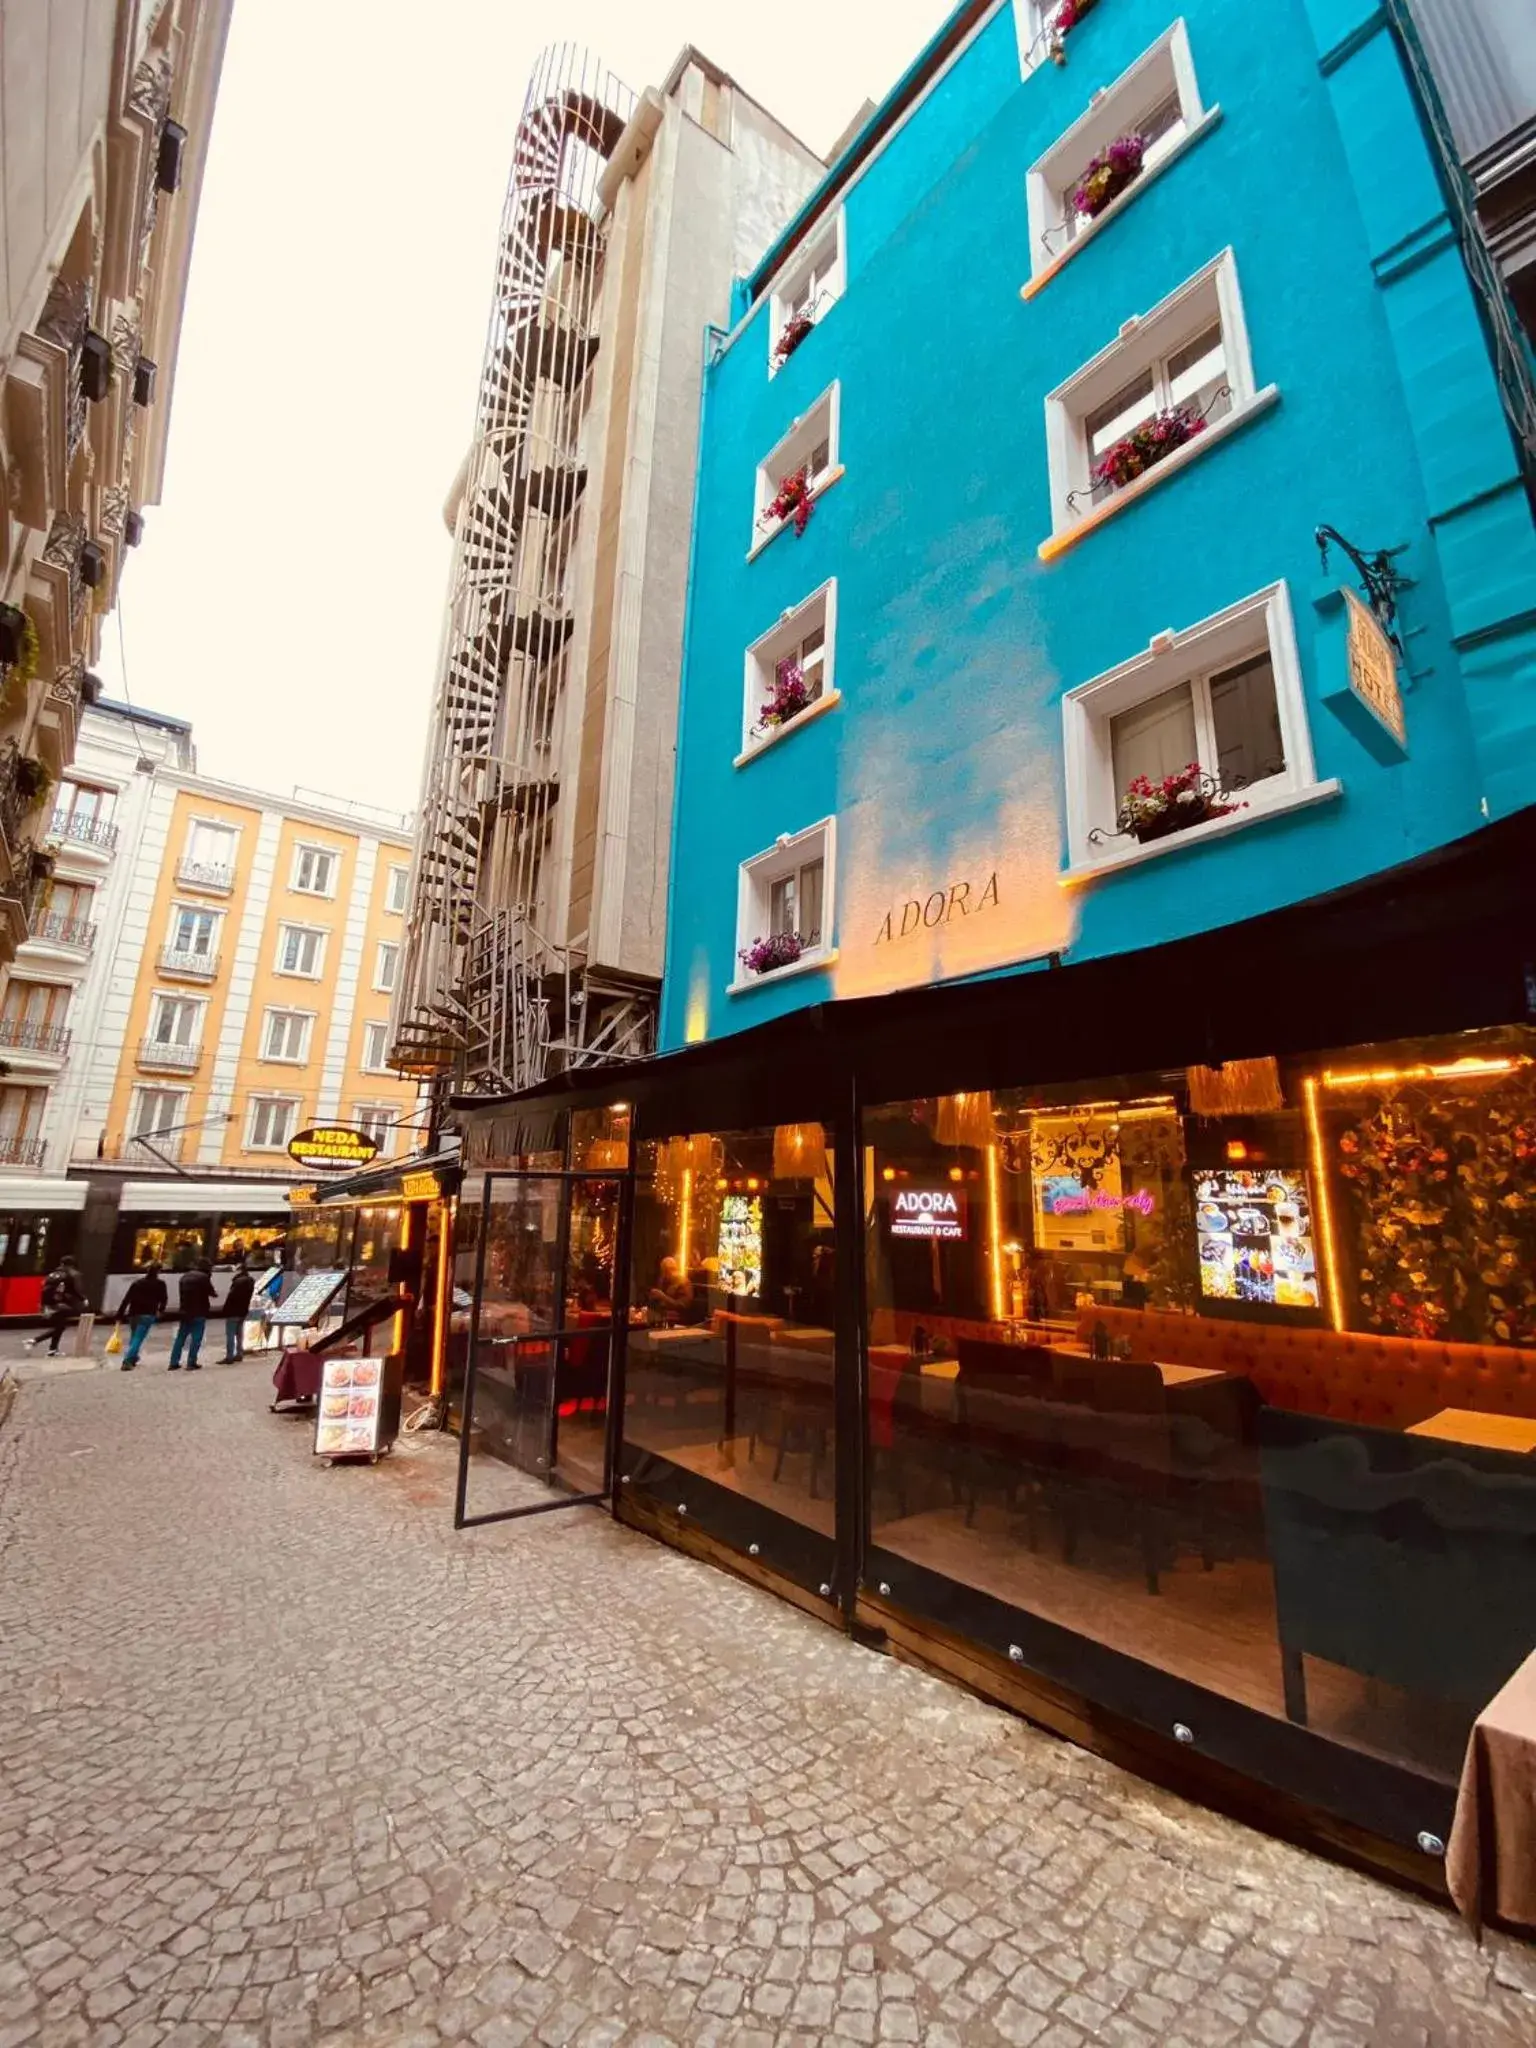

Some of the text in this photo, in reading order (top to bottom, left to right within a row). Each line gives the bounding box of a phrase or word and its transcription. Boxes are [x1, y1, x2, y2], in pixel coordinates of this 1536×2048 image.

[873, 871, 1000, 946] ADORA
[312, 1130, 359, 1145] NEDA
[291, 1141, 376, 1159] RESTAURANT
[895, 1192, 957, 1213] ADORA
[891, 1224, 934, 1236] RESTAURANT
